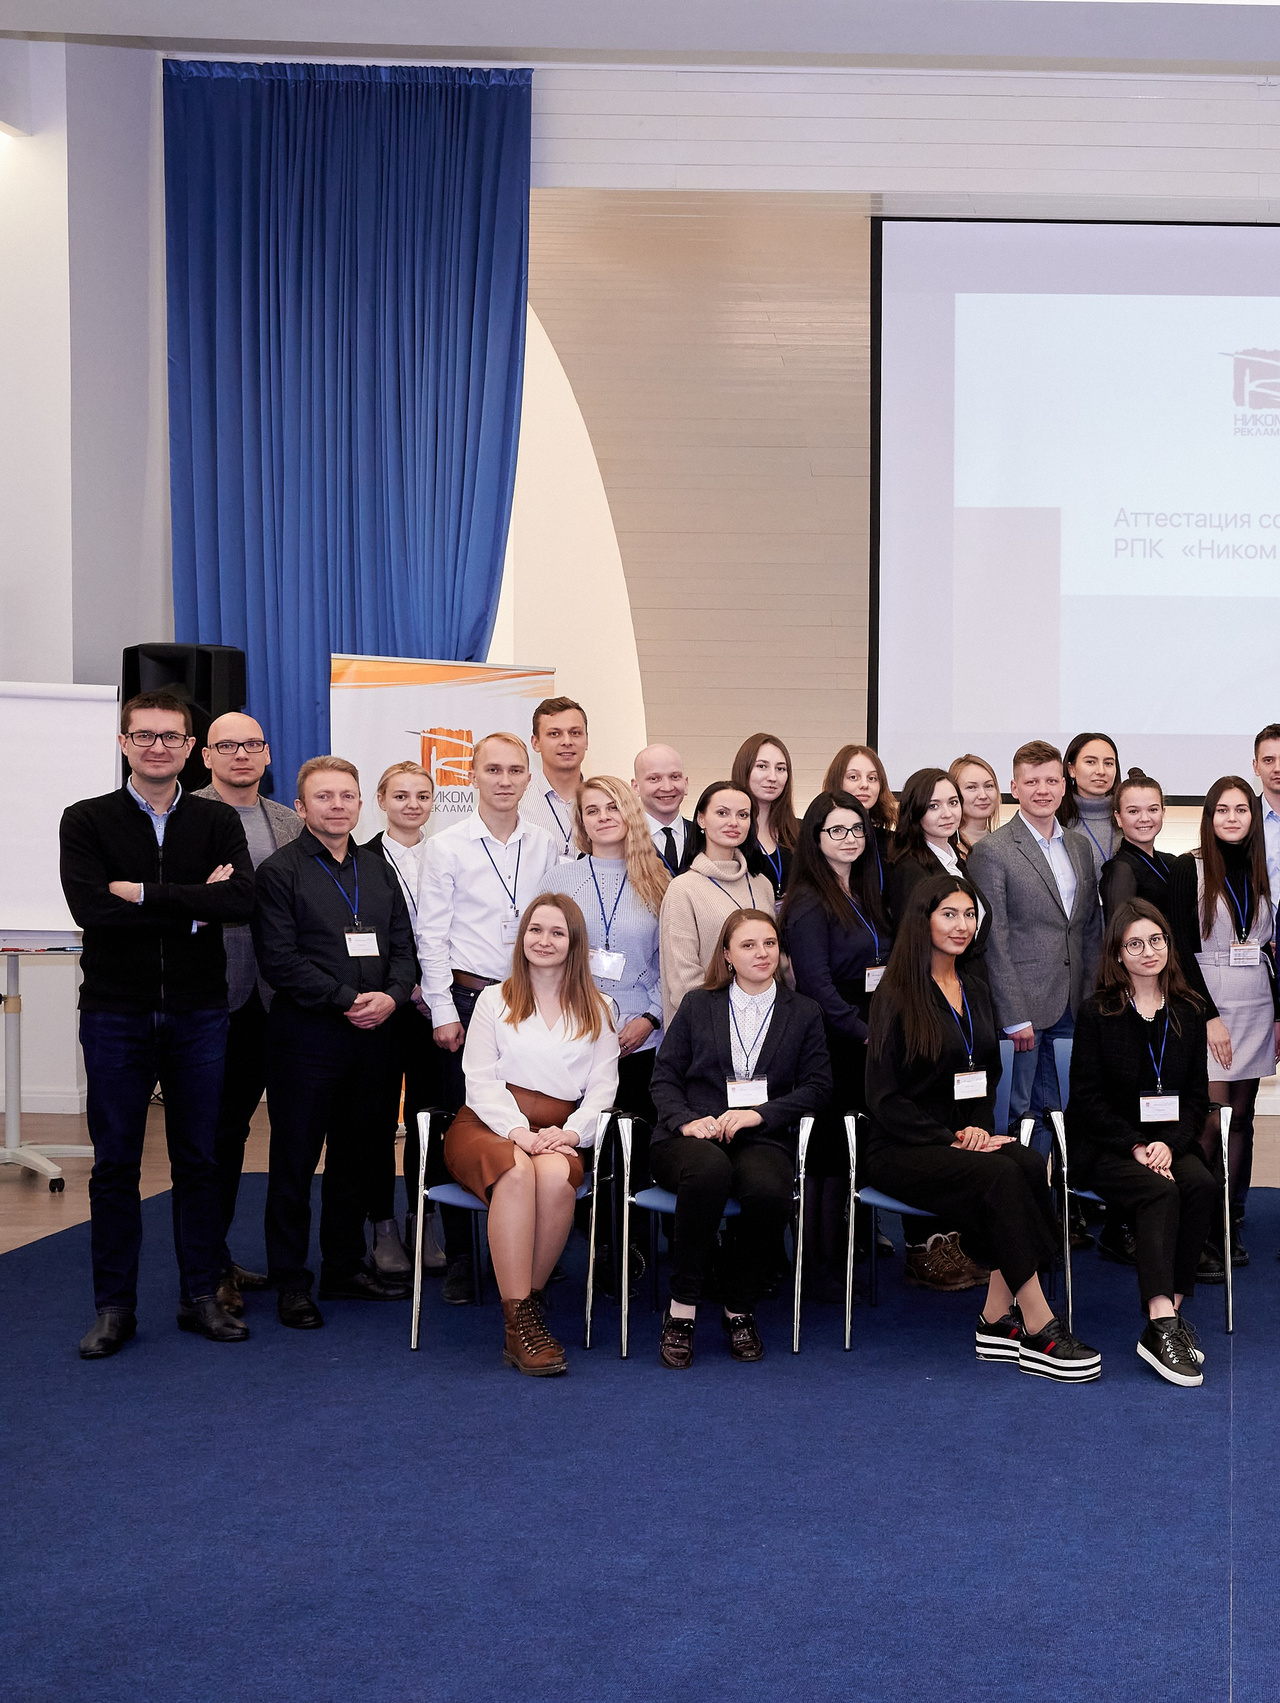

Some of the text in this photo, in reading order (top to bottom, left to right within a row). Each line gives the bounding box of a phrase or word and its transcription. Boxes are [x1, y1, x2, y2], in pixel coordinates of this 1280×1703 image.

[1114, 507, 1251, 531] Аттестация
[1114, 538, 1164, 558] РПК
[1182, 539, 1277, 560] «Ником
[434, 791, 474, 803] ИКОМ
